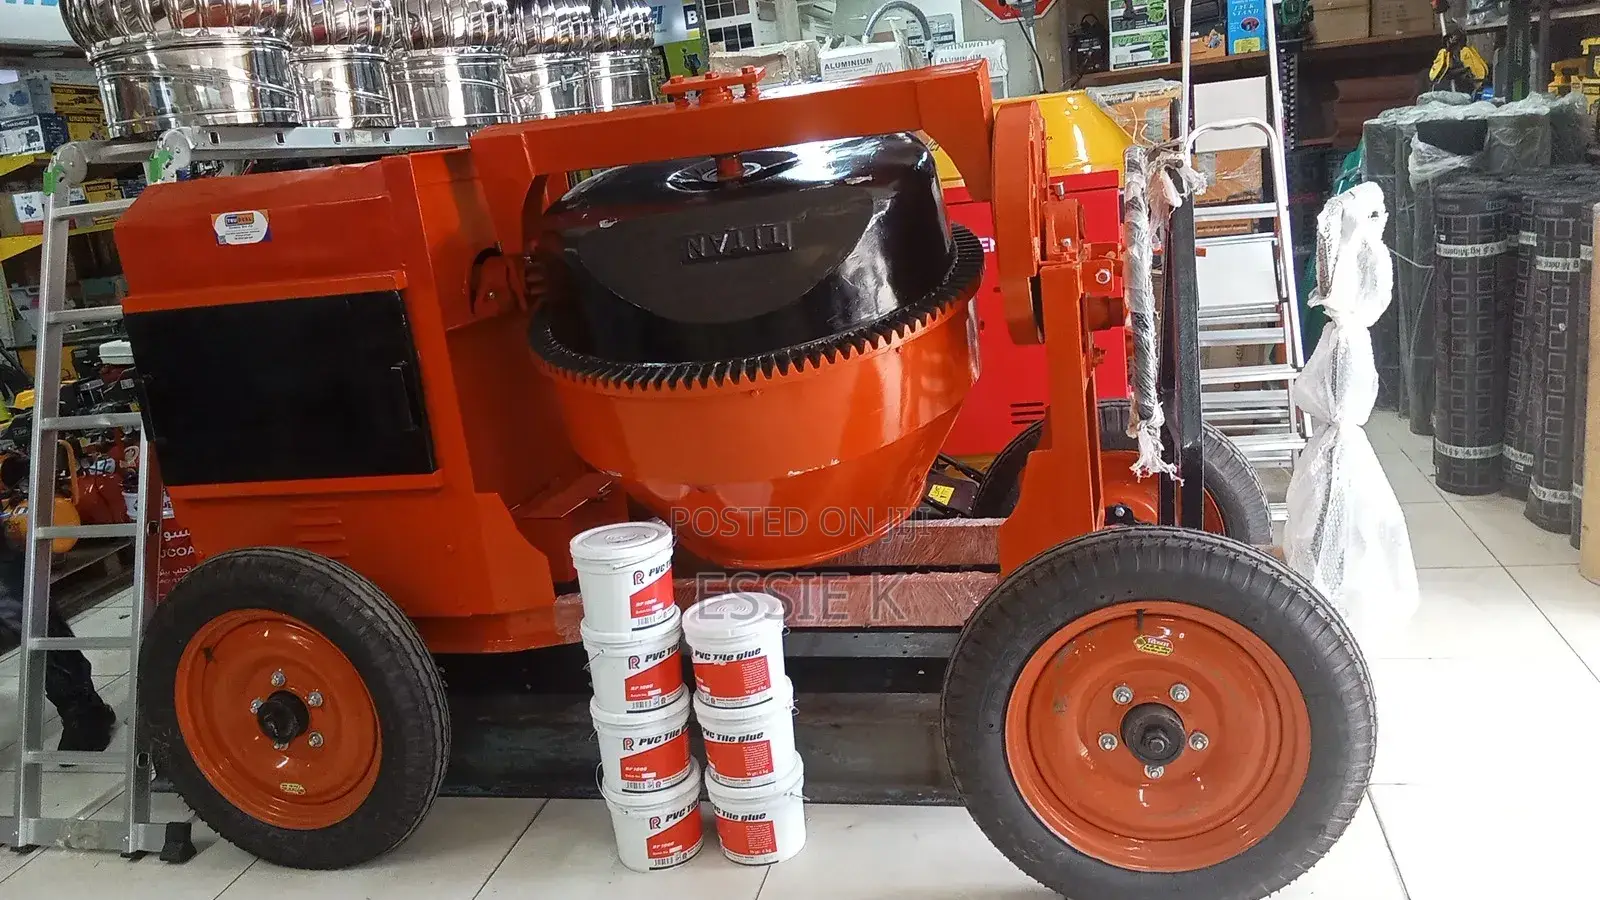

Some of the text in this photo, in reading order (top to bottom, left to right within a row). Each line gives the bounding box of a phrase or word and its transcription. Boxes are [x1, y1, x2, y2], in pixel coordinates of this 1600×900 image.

[824, 57, 873, 71] ALUMINIUM
[648, 564, 665, 576] PVC
[645, 650, 666, 662] PVC
[694, 650, 711, 661] PVC
[736, 647, 762, 661] glue
[639, 735, 661, 746] PVC
[716, 733, 736, 742] Tile
[737, 731, 764, 743] glue
[665, 808, 685, 822] PVC
[741, 812, 767, 822] glue
